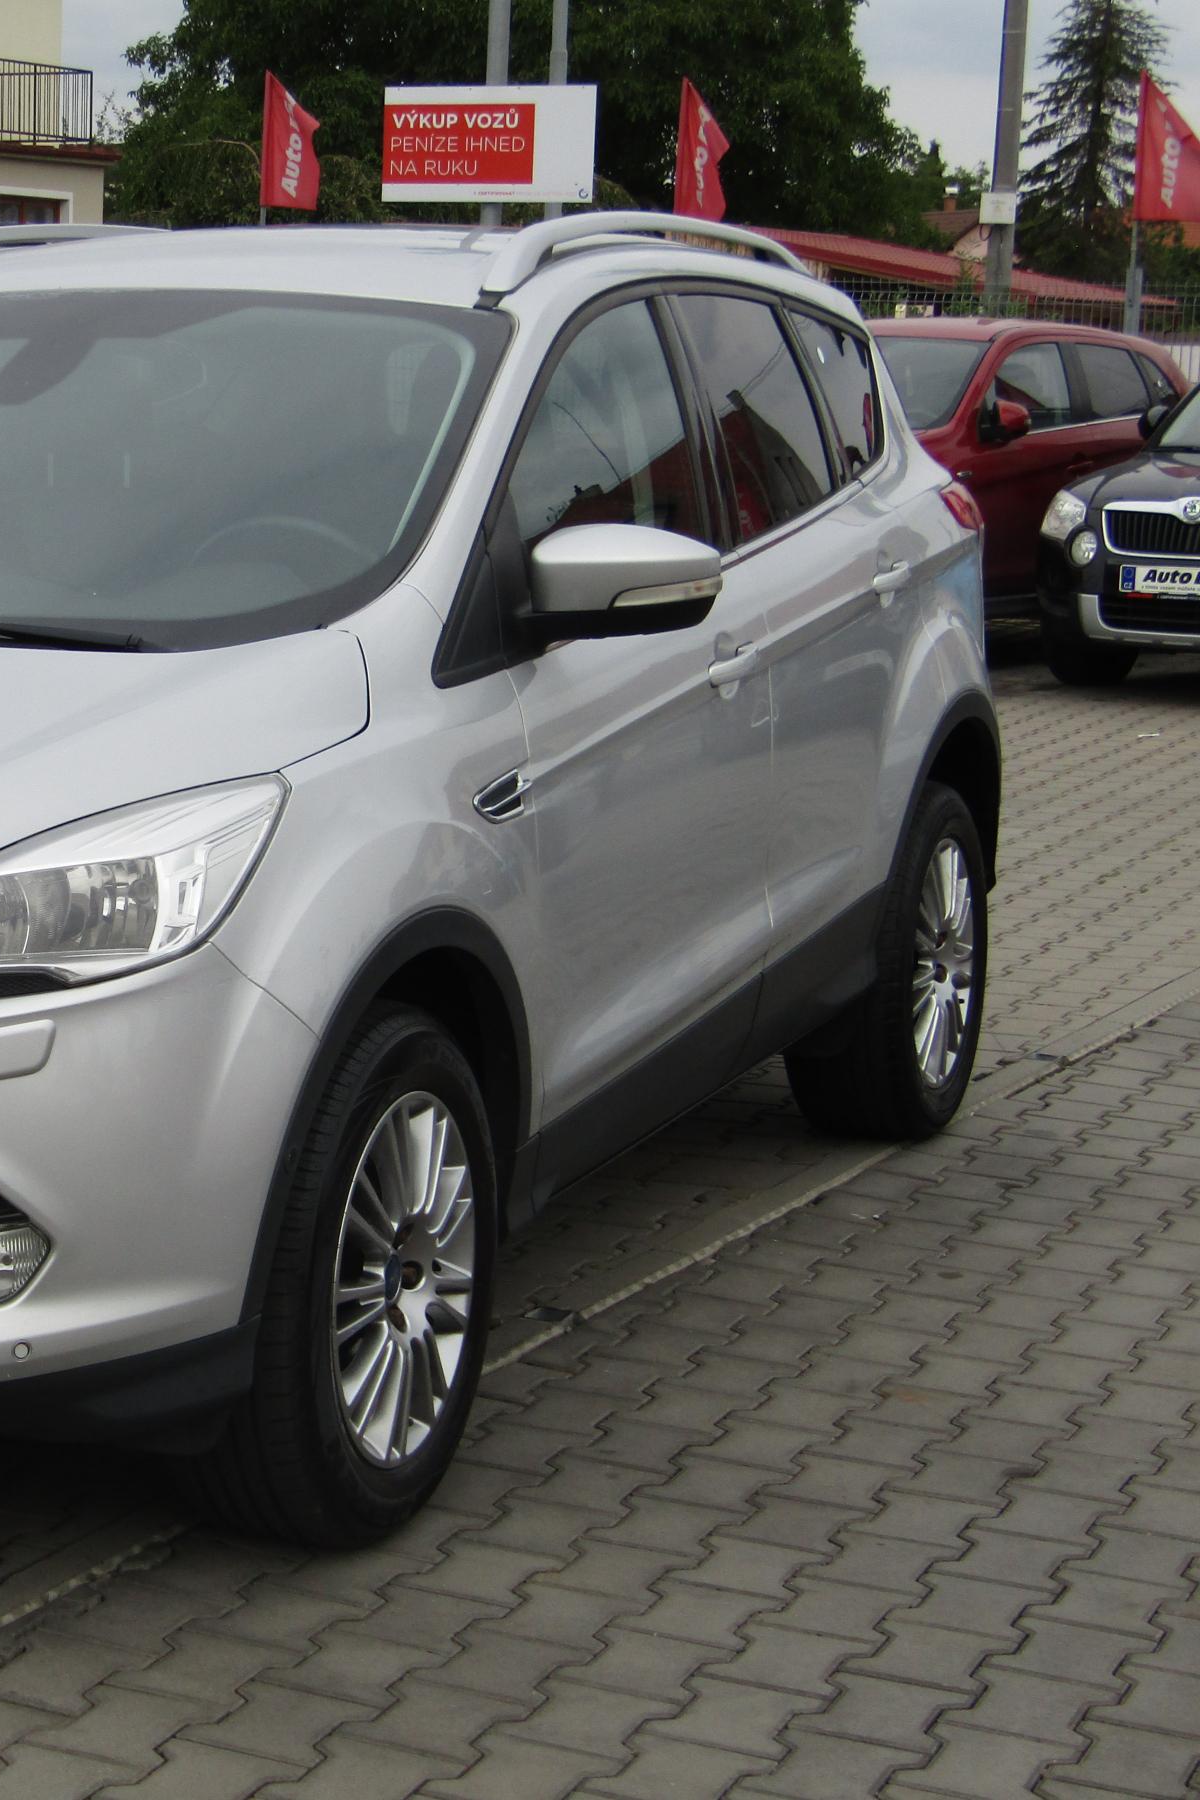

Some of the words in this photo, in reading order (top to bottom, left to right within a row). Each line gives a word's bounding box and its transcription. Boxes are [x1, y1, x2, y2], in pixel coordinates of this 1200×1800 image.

[392, 110, 458, 129] VÝKUP
[464, 108, 519, 129] VOZŮ
[390, 134, 458, 153] PENÍZE
[465, 136, 525, 153] IHNED
[281, 133, 302, 198] Auto
[390, 160, 417, 176] NA
[424, 160, 477, 176] RUKU
[1142, 569, 1192, 585] Auto
